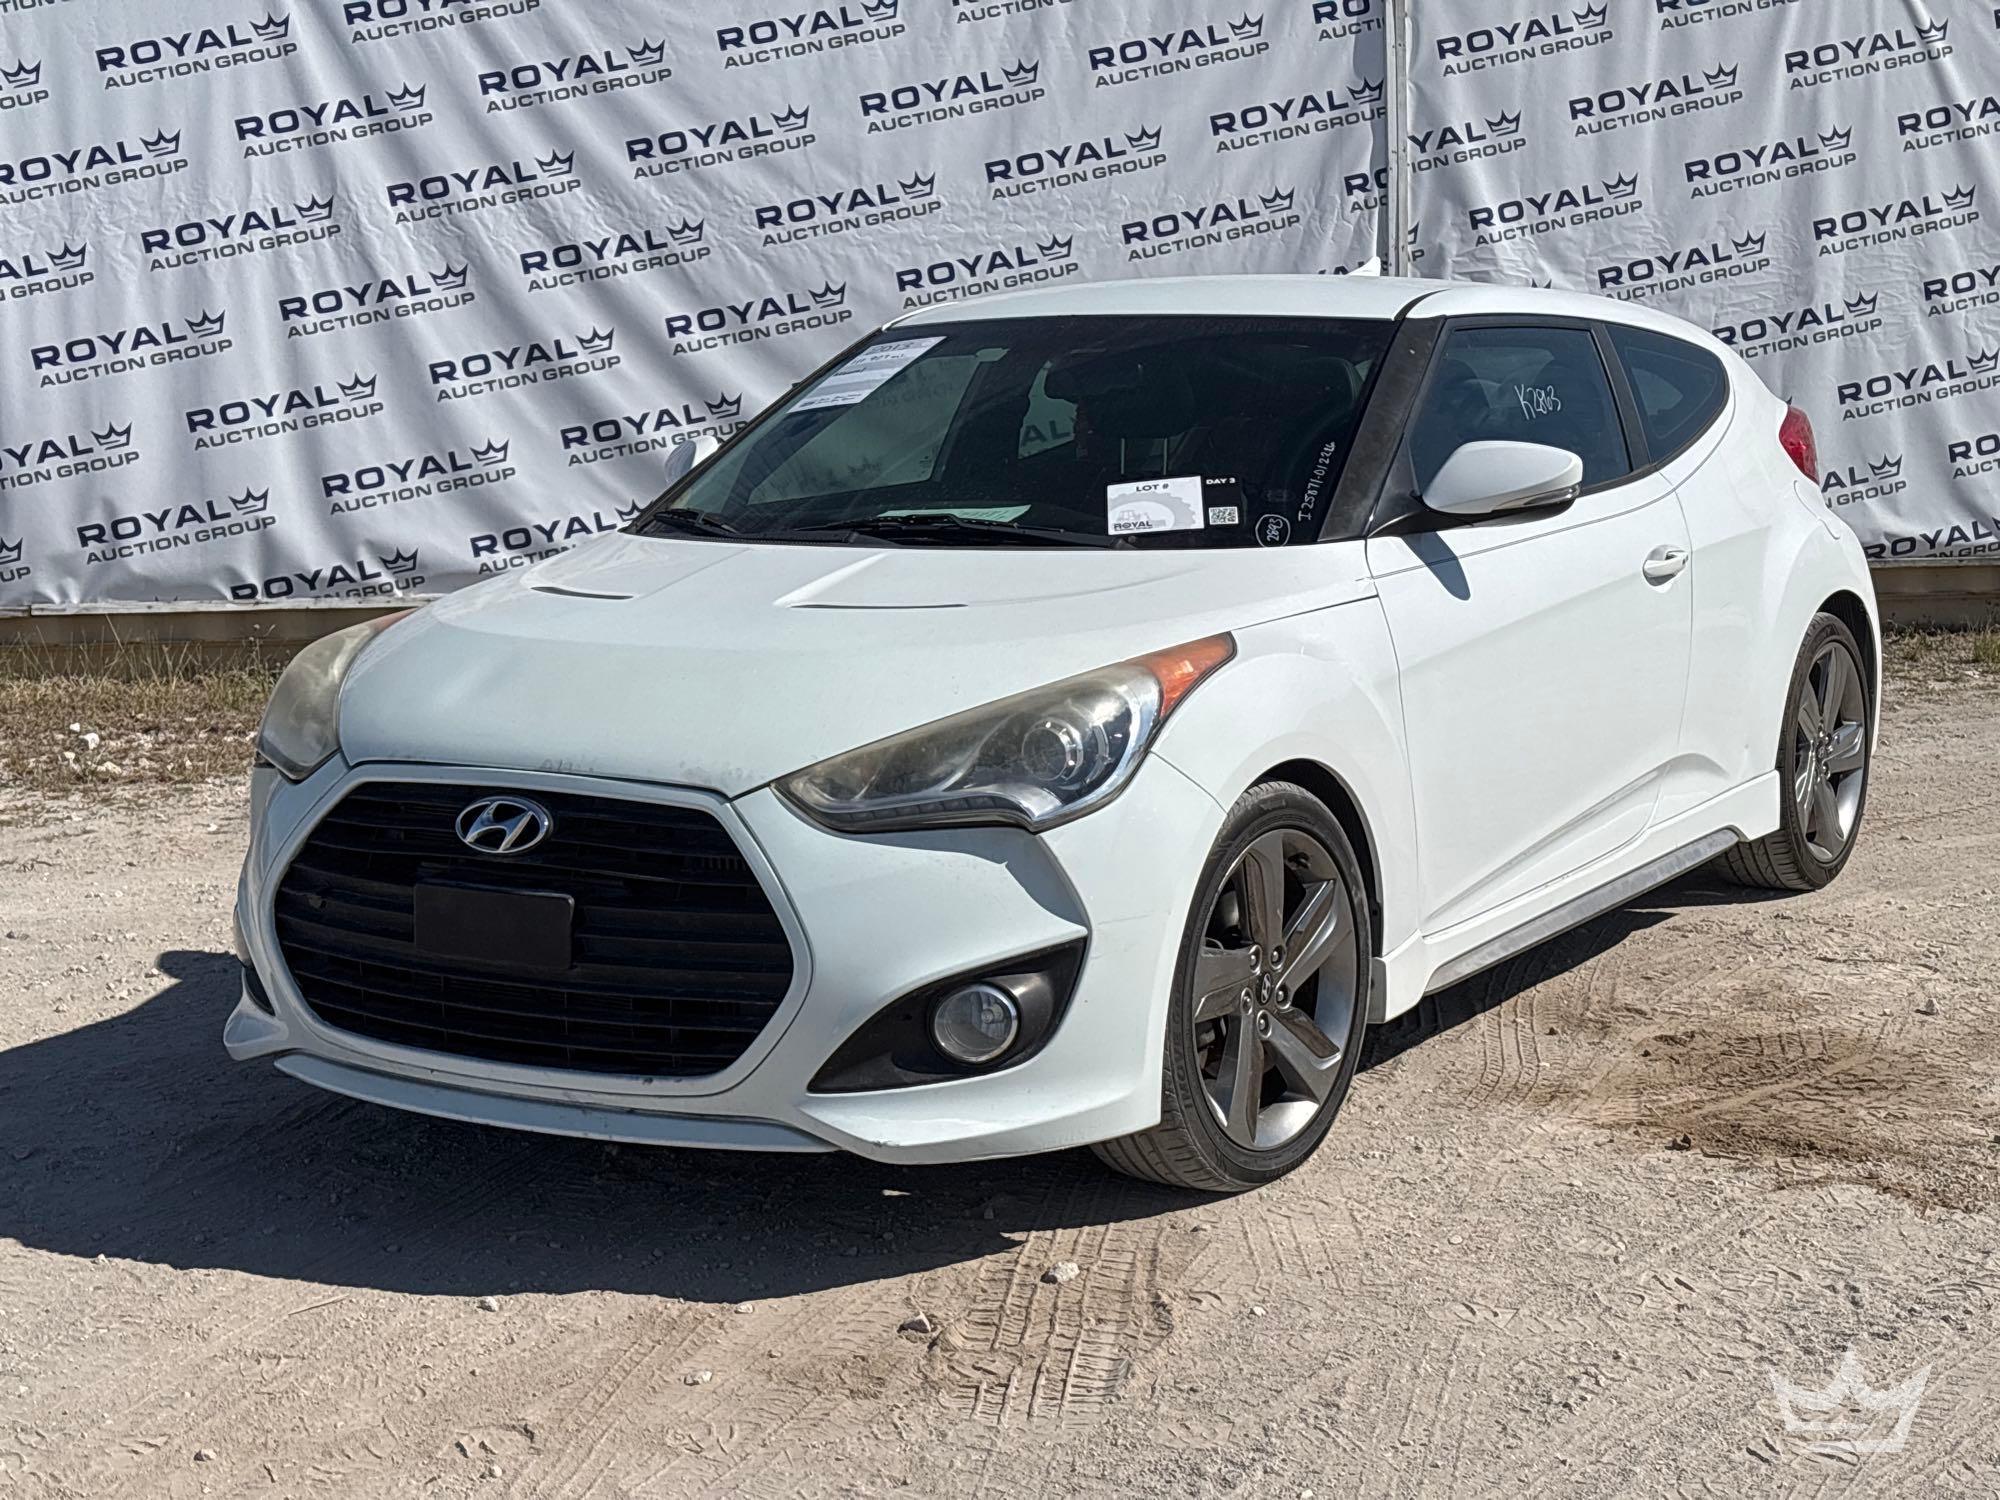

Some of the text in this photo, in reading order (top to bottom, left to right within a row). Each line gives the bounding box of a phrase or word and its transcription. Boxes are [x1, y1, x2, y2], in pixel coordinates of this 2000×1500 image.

[352, 14, 455, 44] AUCTION
[459, 0, 540, 23] GROUP
[717, 6, 863, 51] ROYAL
[957, 0, 1054, 24] AUCTION
[1318, 17, 1385, 42] AUCTI
[1661, 0, 1752, 30] AUCTION
[96, 25, 252, 71] ROYAL
[725, 24, 905, 69] AUCTION GROUP
[1088, 25, 1229, 70] ROYAL
[1437, 15, 1574, 60] ROYAL
[1443, 31, 1613, 77] AUCTION GROUP
[1785, 30, 1916, 73] ROYAL
[105, 43, 297, 89] AUCTION GROUP
[478, 51, 628, 95] ROYAL
[1096, 42, 1269, 88] AUCTION GROUP
[1790, 46, 1953, 90] AUCTION GROUP
[0, 90, 49, 110] OUP
[487, 69, 671, 113] AUCTION GROUP
[860, 72, 1003, 116] ROYAL
[868, 88, 1044, 134] AUCTION GROUP
[1210, 91, 1349, 136] ROYAL
[1569, 75, 1704, 120] ROYAL
[235, 95, 389, 141] ROYAL
[244, 113, 432, 159] AUCTION GROUP
[1575, 91, 1742, 137] AUCTION GROUP
[1898, 97, 2000, 136] ROYA
[626, 117, 773, 162] ROYAL
[634, 134, 815, 179] AUCTION GROUP
[985, 138, 1127, 183] ROYAL
[1217, 123, 1310, 153] AUCTION
[1407, 122, 1487, 154] YAL
[1454, 138, 1526, 163] GROUP
[1685, 137, 1819, 182] ROYAL
[1904, 124, 1990, 152] AUCTION
[105, 159, 188, 184] GROUP
[387, 162, 537, 207] ROYAL
[992, 154, 1166, 200] AUCTION GROUP
[1691, 153, 1856, 199] AUCTION GROUP
[396, 179, 581, 224] AUCTION GROUP
[755, 184, 900, 229] ROYAL
[763, 201, 941, 247] AUCTION GROUP
[1122, 199, 1260, 244] ROYAL
[1468, 185, 1604, 230] ROYAL
[1475, 201, 1642, 247] AUCTION GROUP
[1813, 196, 1942, 240] ROYAL
[141, 207, 296, 253] ROYAL
[150, 224, 341, 272] AUCTION GROUP
[520, 230, 668, 275] ROYAL
[1128, 215, 1300, 261] AUCTION GROUP
[1819, 212, 1979, 256] AUCTION GROUP
[11, 272, 94, 298] GROUP
[528, 247, 710, 292] AUCTION GROUP
[896, 247, 1038, 292] ROYAL
[903, 263, 1078, 309] AUCTION GROUP
[1598, 243, 1732, 289] ROYAL
[1700, 258, 1770, 283] GROUP
[1923, 265, 2000, 301] ROY
[279, 275, 431, 321] ROYAL
[288, 292, 475, 339] AUCTION GROUP
[665, 294, 810, 338] ROYAL
[1928, 292, 1999, 317] AUCTIO
[31, 323, 188, 370] ROYAL
[672, 310, 852, 356] AUCTION GROUP
[1813, 319, 1882, 343] GROUP
[41, 339, 232, 388] AUCTION GROUP
[429, 339, 578, 384] ROYAL
[437, 356, 620, 402] AUCTION GROUP
[1838, 360, 1967, 405] ROYAL
[186, 386, 339, 433] ROYAL
[195, 403, 383, 450] AUCTION GROUP
[560, 404, 707, 449] ROYAL
[1843, 391, 1931, 421] AUCTION
[0, 435, 94, 471] YAL
[0, 452, 139, 491] TION GROUP
[569, 437, 666, 466] AUCTION
[321, 451, 472, 498] ROYAL
[330, 468, 515, 515] AUCTION GROUP
[1136, 484, 1159, 492] LOT
[1837, 481, 1906, 505] GROUP
[77, 500, 231, 548] ROYAL
[87, 515, 277, 565] AUCTION GROUP
[470, 512, 617, 558] ROYAL
[1113, 520, 1153, 531] ROYAL
[478, 544, 576, 575] AUCTI
[1957, 540, 2000, 558] GRO
